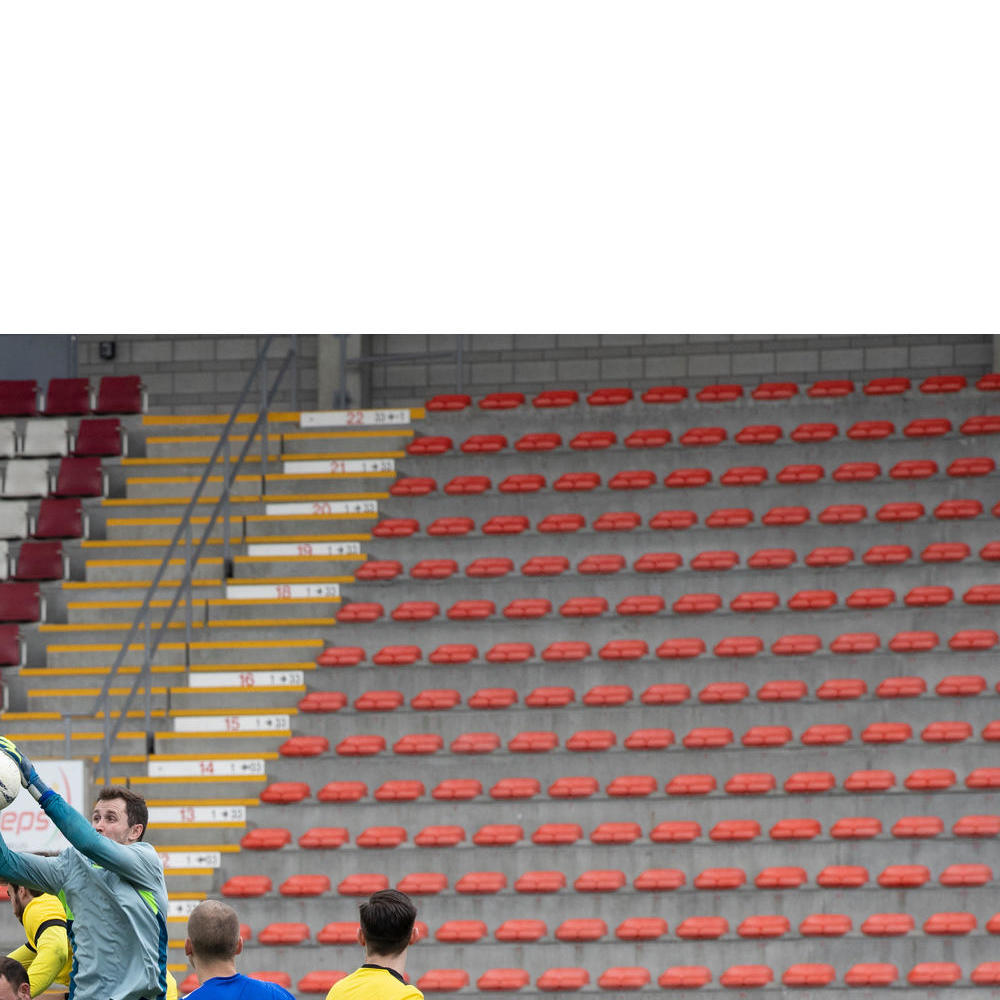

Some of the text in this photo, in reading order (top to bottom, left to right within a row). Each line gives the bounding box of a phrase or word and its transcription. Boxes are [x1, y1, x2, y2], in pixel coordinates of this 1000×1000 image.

[346, 411, 364, 425] 22
[331, 461, 345, 473] 21
[313, 502, 331, 514] 20
[297, 544, 312, 555] 19
[276, 585, 291, 598] 18
[239, 673, 254, 687] 16
[225, 718, 240, 731] 15
[199, 761, 213, 775] 14
[179, 808, 195, 821] 13
